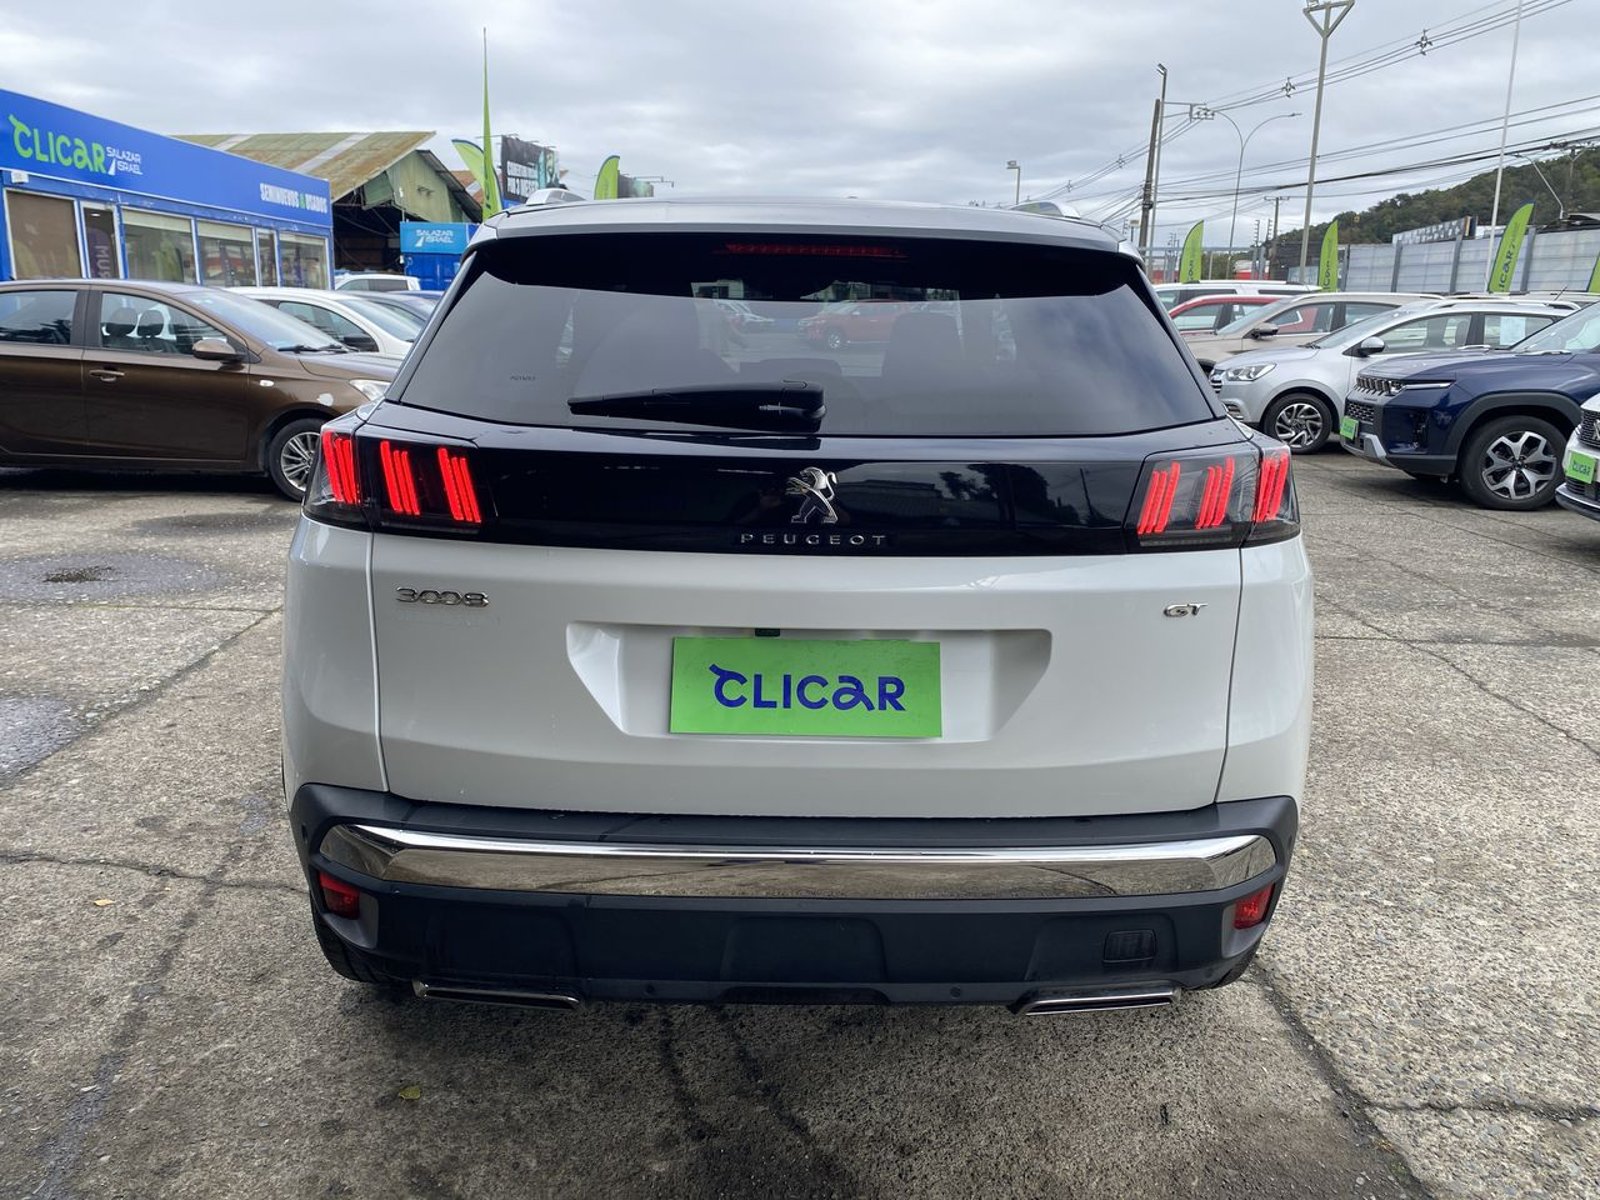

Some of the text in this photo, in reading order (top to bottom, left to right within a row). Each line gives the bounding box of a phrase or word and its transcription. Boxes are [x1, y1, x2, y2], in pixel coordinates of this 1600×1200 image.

[106, 146, 142, 164] SALAZAR
[739, 532, 887, 547] PEUGEOT
[395, 586, 490, 608] 3008
[1163, 602, 1209, 618] GT
